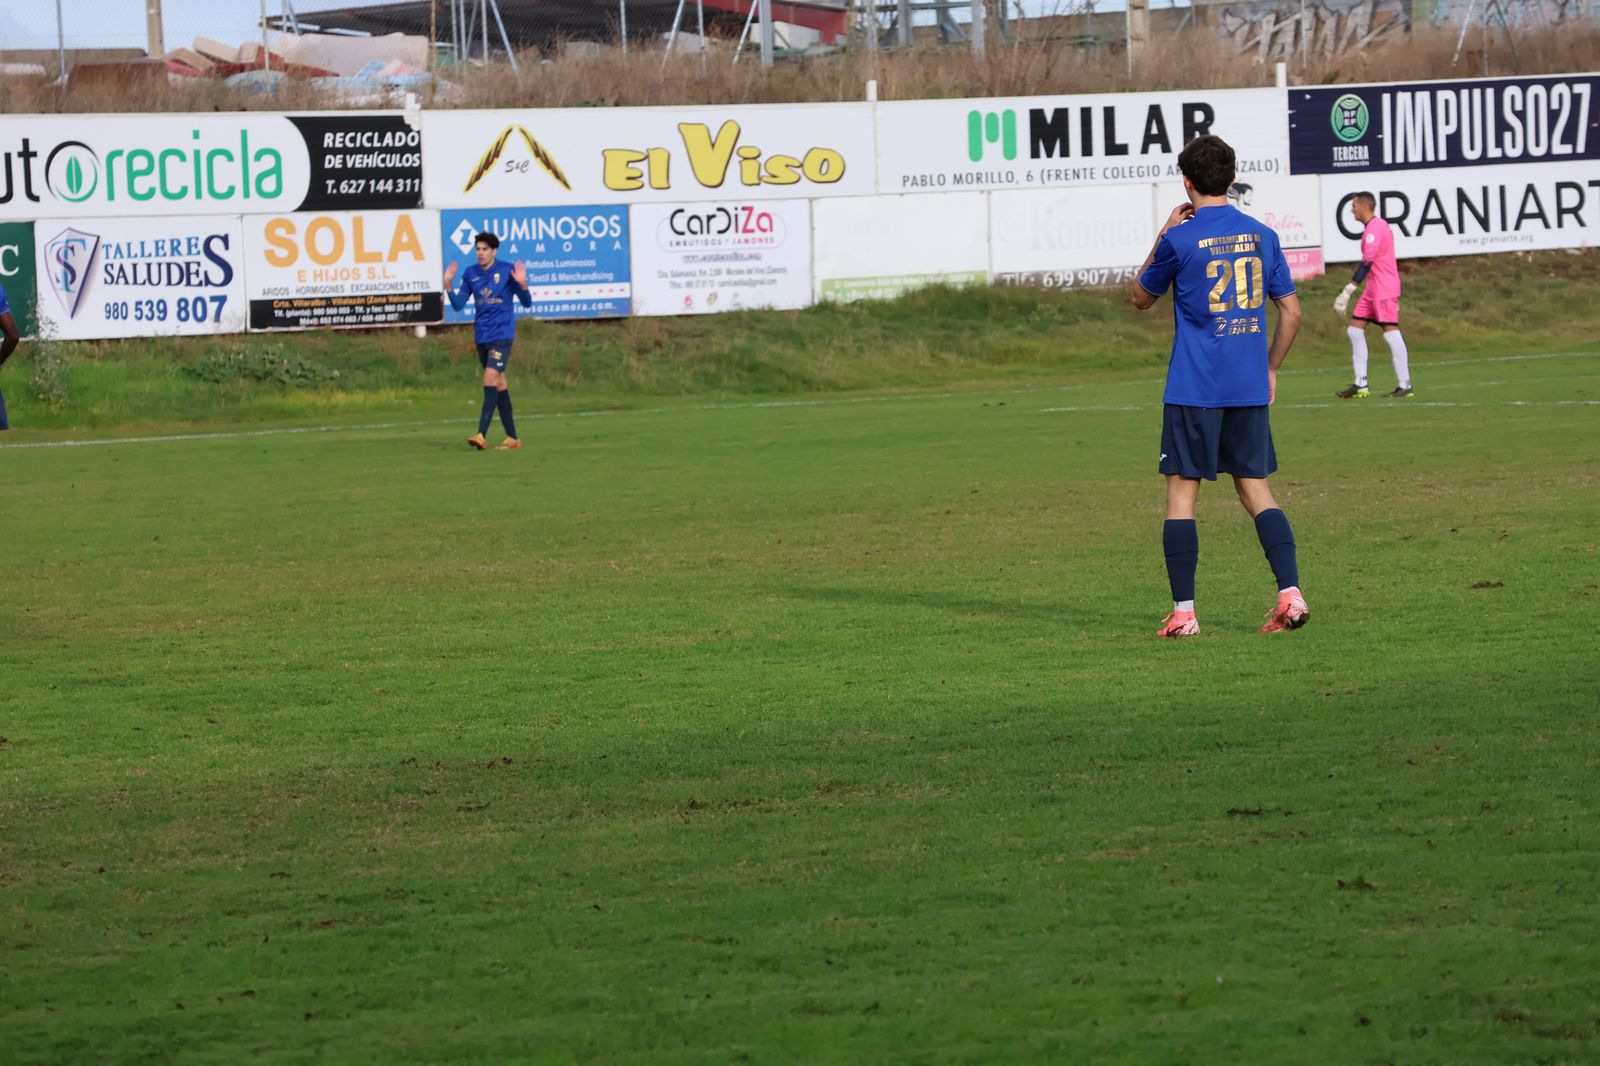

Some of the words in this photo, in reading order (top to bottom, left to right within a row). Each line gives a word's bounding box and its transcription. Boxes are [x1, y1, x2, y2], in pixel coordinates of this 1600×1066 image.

[1029, 102, 1215, 159] MILAR
[1382, 83, 1591, 165] IMPULSO27
[323, 131, 420, 148] RECICLADO
[324, 154, 343, 169] DE
[346, 151, 421, 168] VEHÍCULOS
[602, 147, 671, 191] El
[677, 119, 847, 189] Viso
[1333, 145, 1369, 161] TERCERA
[326, 180, 337, 194] T.
[340, 179, 365, 194] 627
[369, 179, 393, 193] 144
[395, 178, 420, 193] 311
[902, 175, 947, 188] PABLO
[952, 170, 1020, 186] MORILLO,
[1026, 170, 1034, 183] 6
[1040, 167, 1097, 184] (FRENTE
[1103, 165, 1160, 180] COLEGIO
[263, 214, 425, 268] SOLA
[298, 269, 307, 283] E
[313, 267, 361, 282] HIJOS
[367, 265, 396, 280] S.L.
[1078, 268, 1108, 285] 907
[1206, 256, 1263, 313] 20
[105, 302, 129, 320] 980
[134, 300, 168, 321] 539
[176, 294, 228, 323] 807
